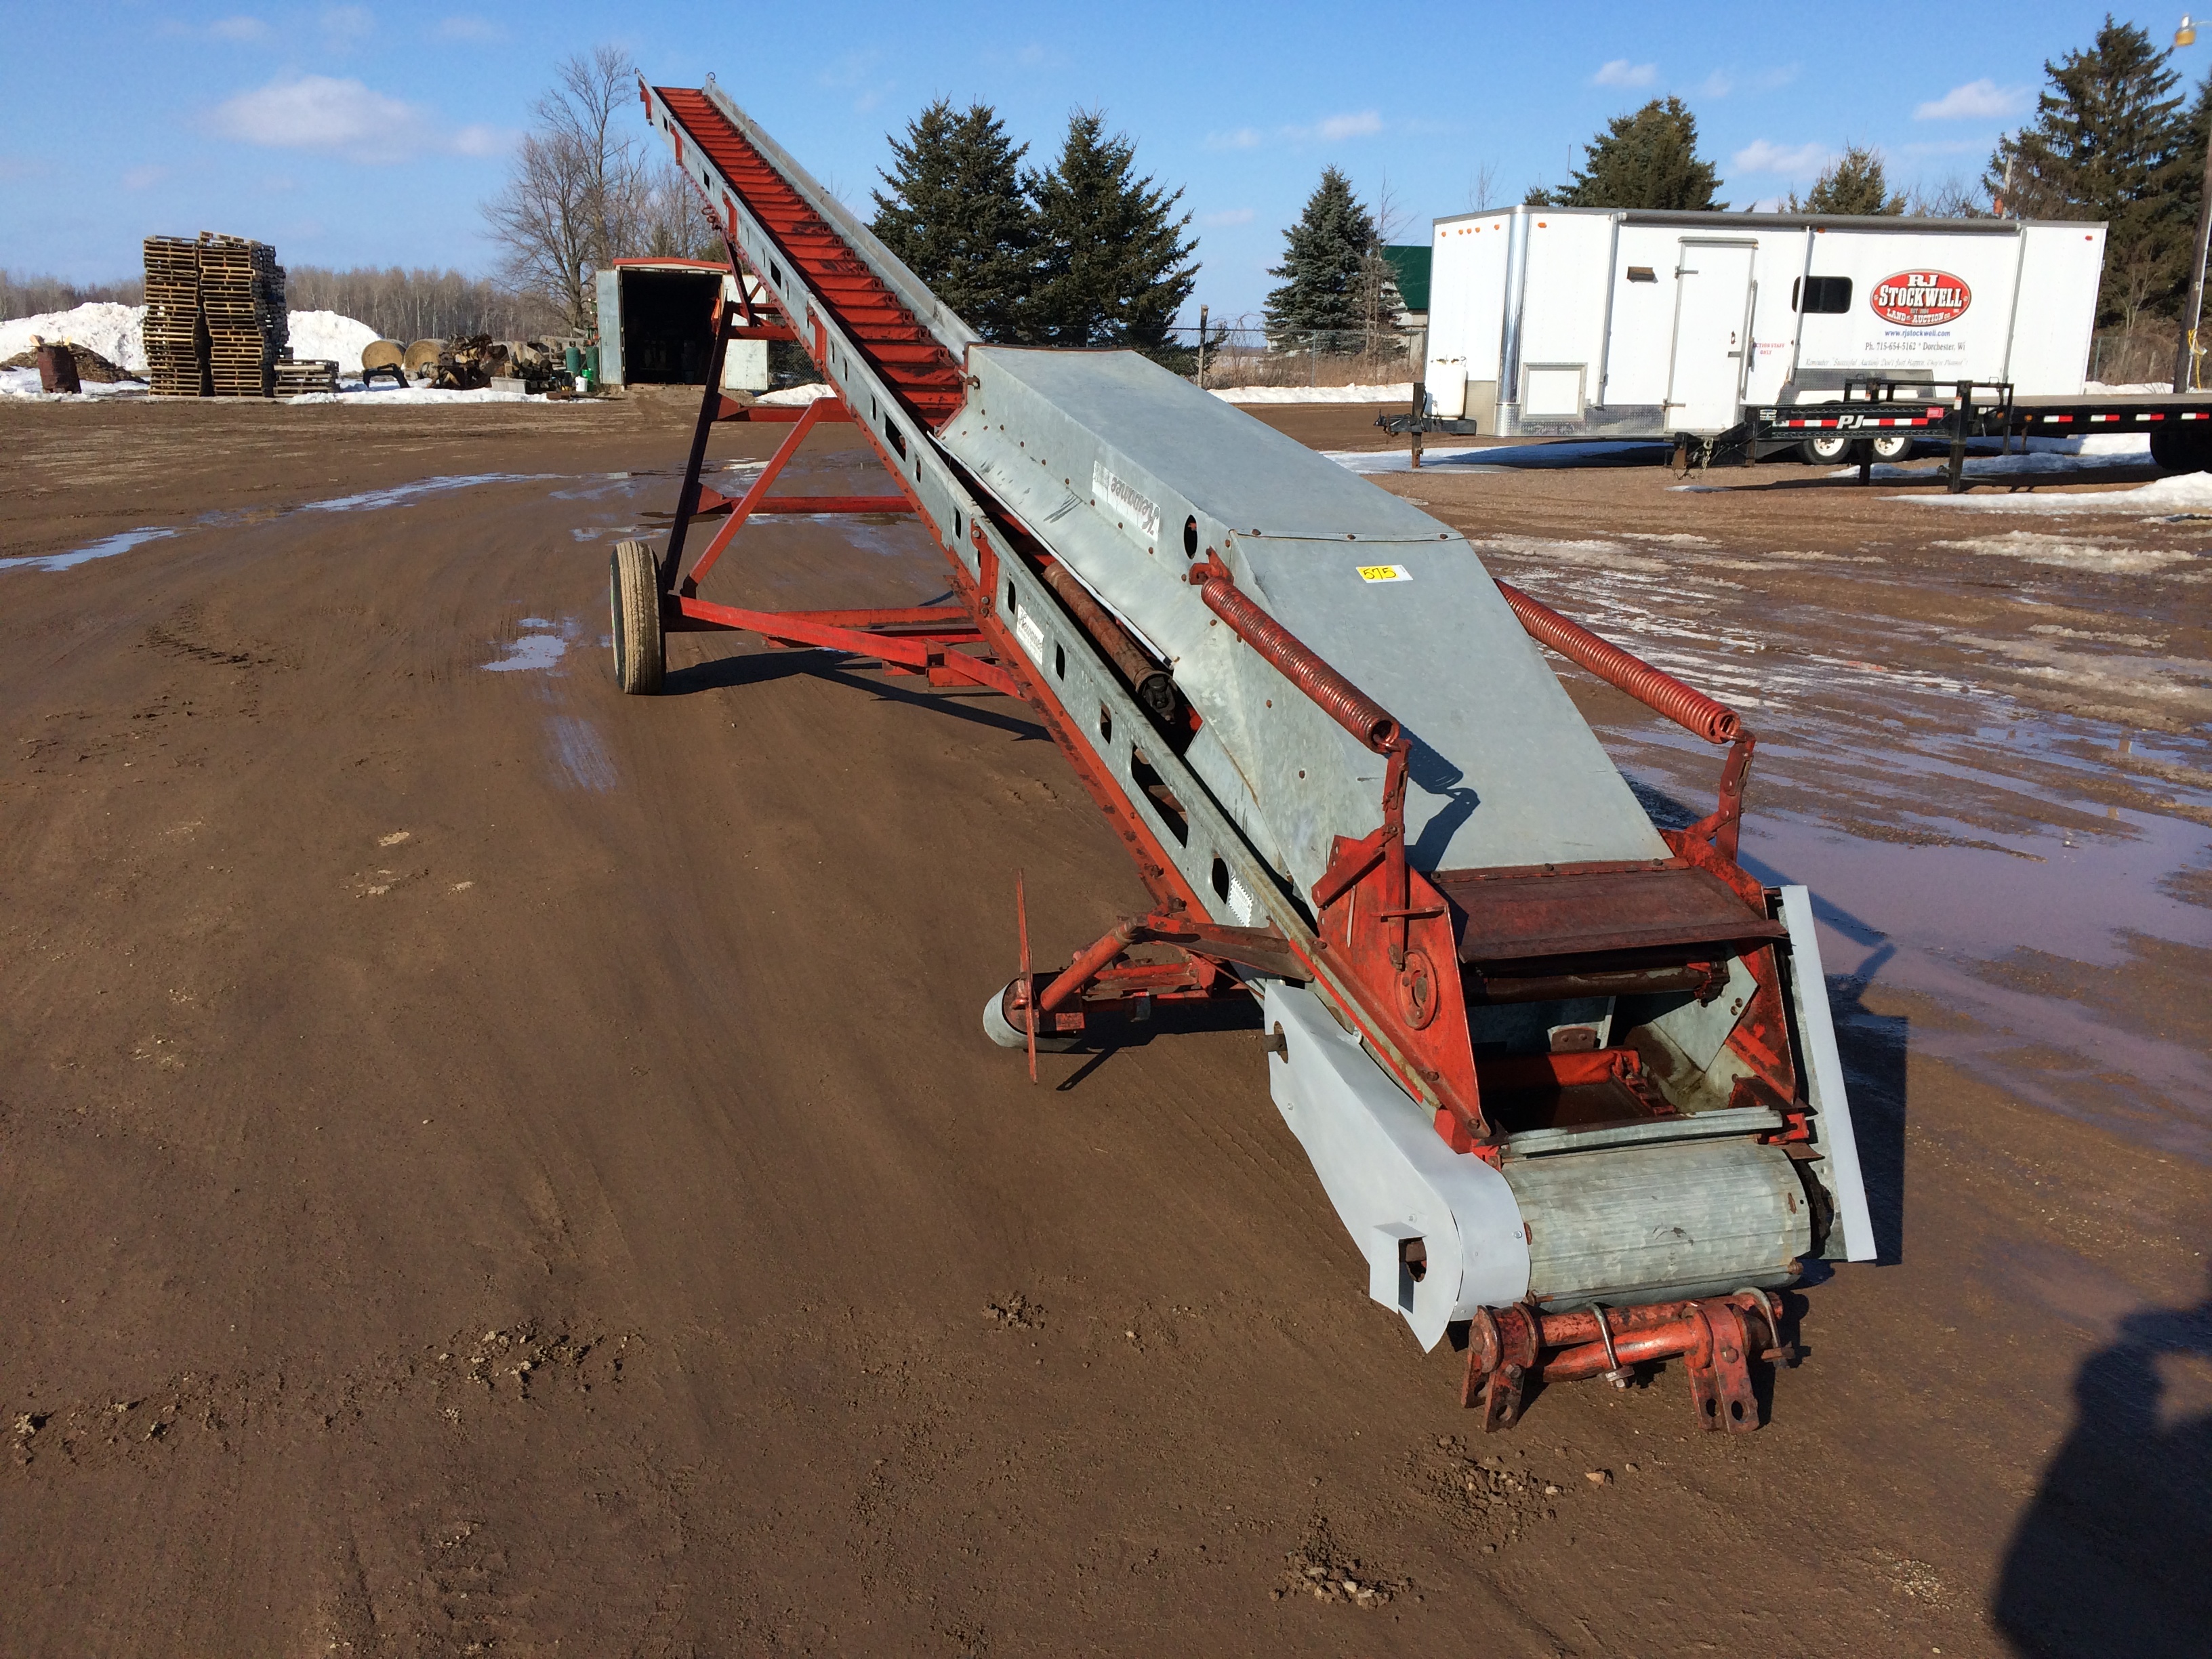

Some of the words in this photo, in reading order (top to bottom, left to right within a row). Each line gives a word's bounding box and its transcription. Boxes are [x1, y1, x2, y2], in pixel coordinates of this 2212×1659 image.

[1907, 274, 1939, 287] RJ
[1879, 285, 1963, 308] STOCKWELL
[1887, 308, 1906, 321] LAND
[1912, 312, 1944, 323] AUCTION
[1885, 329, 1950, 337] www.rjstockwell.com
[1877, 342, 1917, 350] 715-654-5162
[1836, 415, 1865, 430] PJ
[1109, 476, 1160, 536] Kewanee
[1363, 567, 1397, 579] 575
